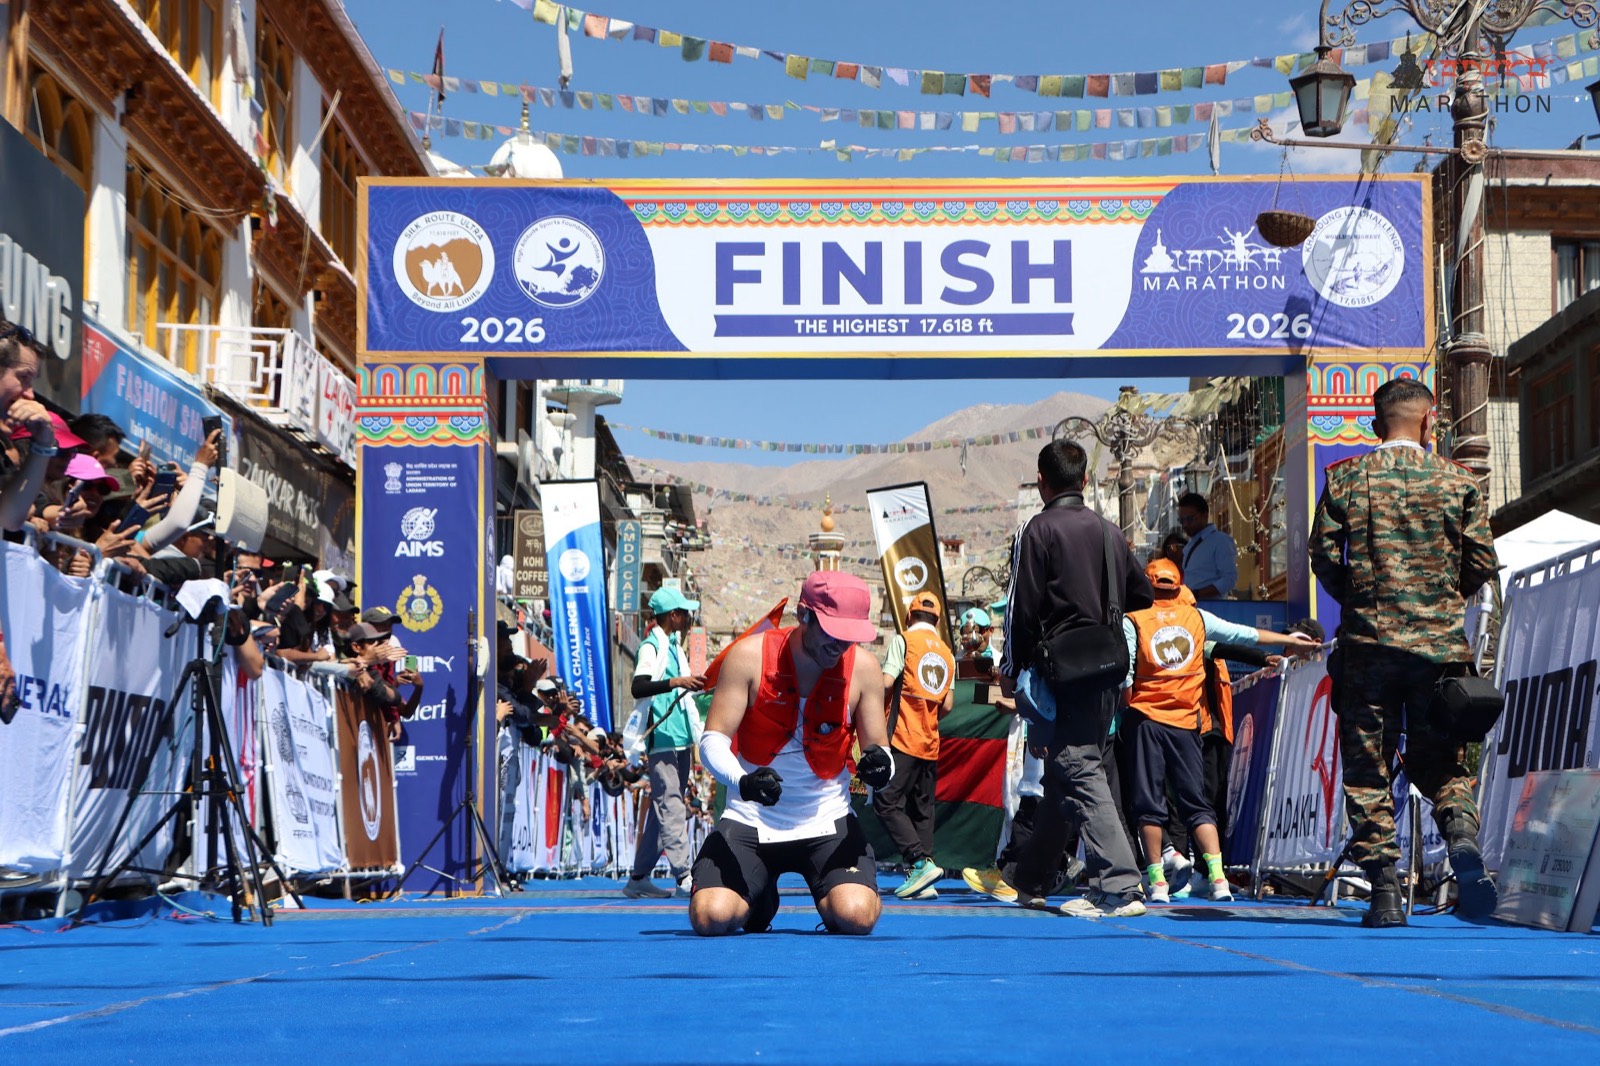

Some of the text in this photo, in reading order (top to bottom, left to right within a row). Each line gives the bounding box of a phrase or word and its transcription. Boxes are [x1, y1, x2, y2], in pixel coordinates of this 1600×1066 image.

[404, 213, 484, 241] SILK ROUTE ULTRA
[539, 219, 560, 229] Sports
[561, 219, 593, 241] Foundation
[1304, 211, 1342, 253] KHARDUNG
[1359, 209, 1402, 253] CHALLENGE
[715, 239, 1073, 306] FINISH
[1143, 275, 1286, 291] MARATHON
[0, 233, 72, 360] UNG
[411, 289, 481, 309] Beyond All Limits
[459, 316, 546, 343] 2026
[794, 319, 828, 334] THE
[832, 318, 909, 334] HIGHEST
[977, 318, 994, 333] ft
[1226, 313, 1313, 339] 2026
[116, 363, 179, 430] FASHION
[295, 490, 320, 530] ARTS
[394, 541, 445, 557] AIMS
[623, 522, 636, 564] AMDO
[522, 556, 543, 567] KOHI
[516, 570, 548, 581] COFFEE
[520, 584, 544, 595] SHOP
[566, 600, 582, 677] CHALLENGE
[584, 626, 592, 647] Race
[586, 647, 596, 692] Endurance
[574, 678, 585, 696] LA
